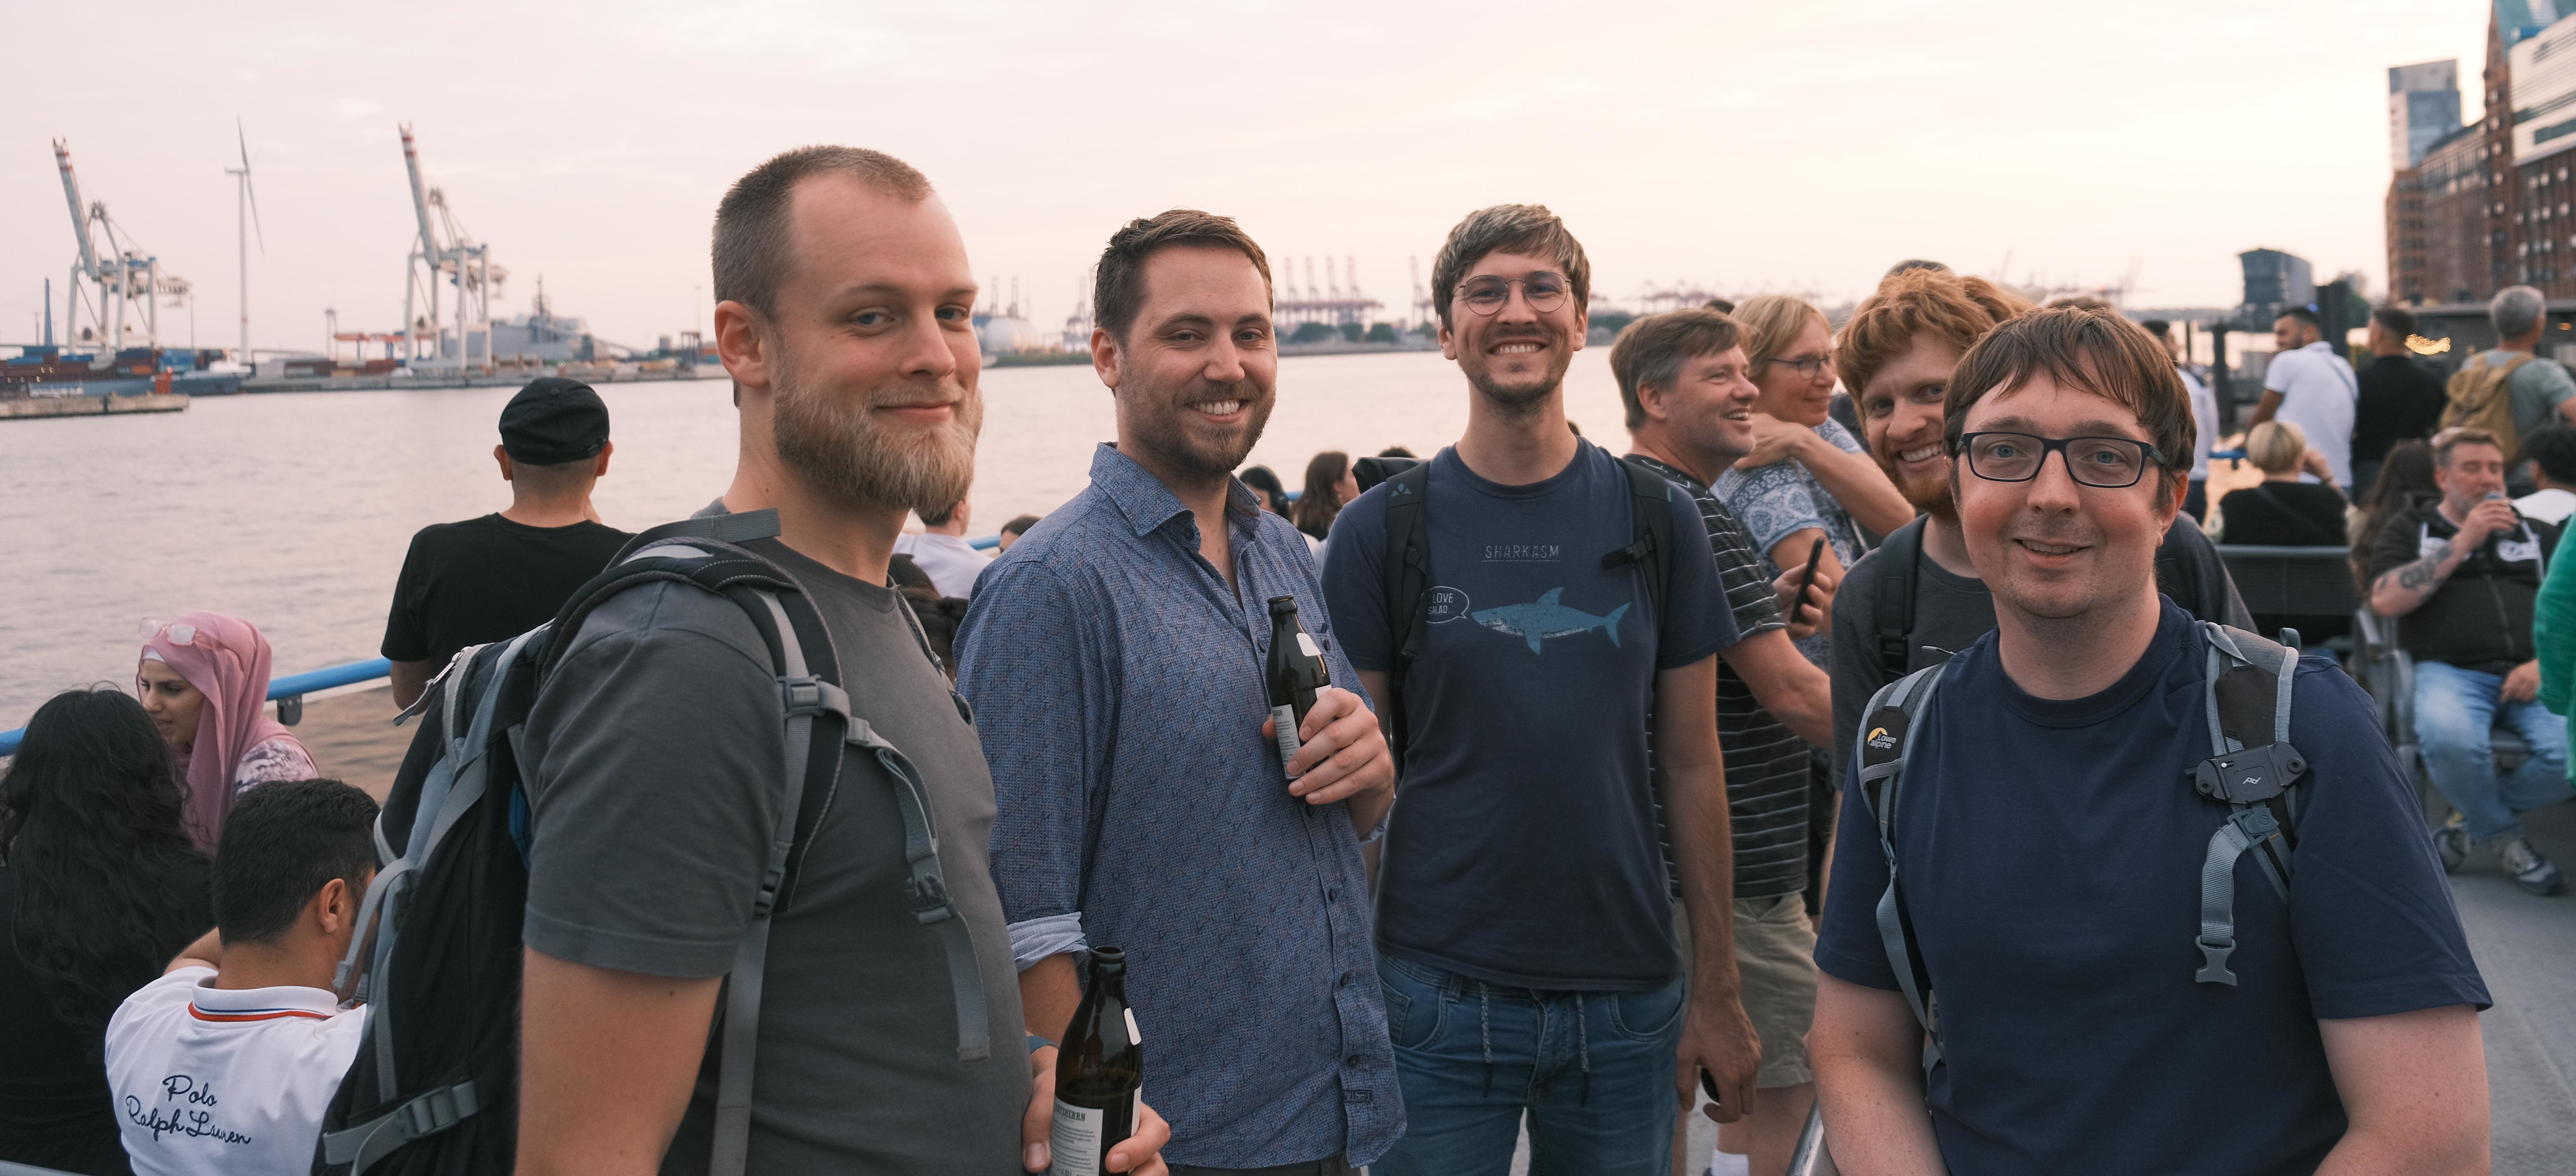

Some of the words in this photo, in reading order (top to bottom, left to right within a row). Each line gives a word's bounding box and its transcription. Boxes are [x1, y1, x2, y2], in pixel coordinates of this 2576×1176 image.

[1486, 545, 1559, 559] SHARKASM
[1433, 593, 1454, 603] LOVE
[1870, 739, 1892, 749] alpine
[1878, 733, 1896, 743] Lowe
[162, 1074, 217, 1107] Polo
[125, 1095, 185, 1141] Ralph
[185, 1110, 251, 1145] Lauren
